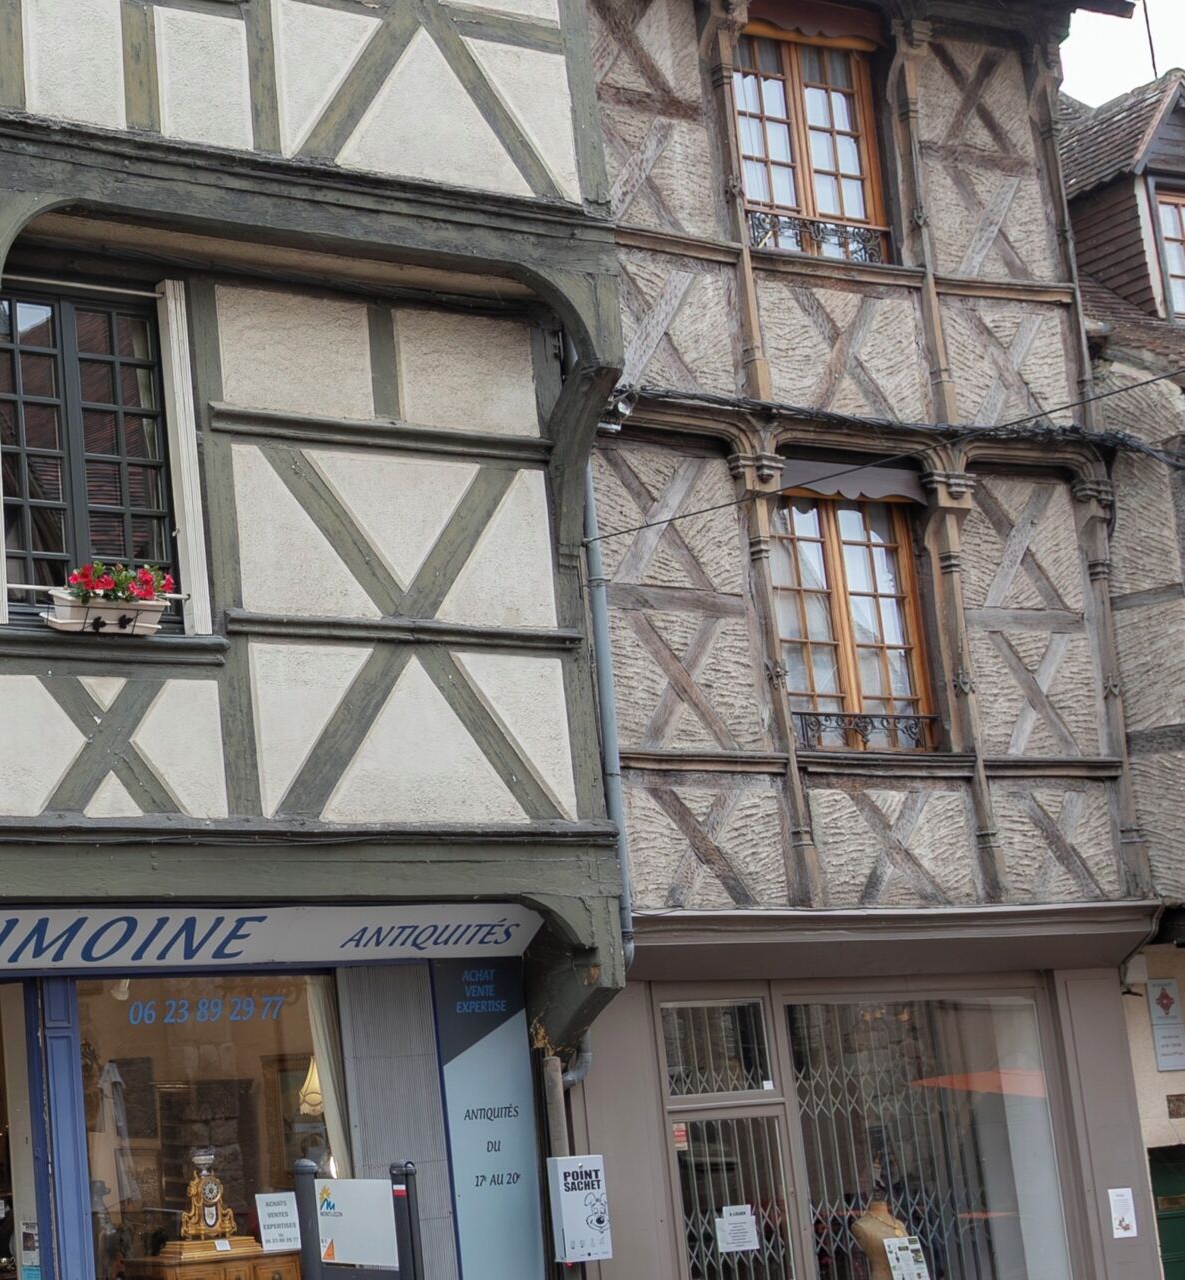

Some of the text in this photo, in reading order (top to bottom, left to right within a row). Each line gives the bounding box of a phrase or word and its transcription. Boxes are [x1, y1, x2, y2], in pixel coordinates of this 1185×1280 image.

[339, 918, 520, 951] ANTIQUITÉS
[462, 969, 495, 982] ACHAT
[465, 985, 495, 997] VENTE
[128, 995, 285, 1025] 06 23 89 29 77
[456, 999, 507, 1013] EXPERTISE
[464, 1104, 519, 1121] ANTIQUITÉS
[486, 1140, 501, 1152] DU
[489, 1173, 504, 1186] AU
[563, 1169, 601, 1181] POINT
[564, 1180, 601, 1192] SACHET
